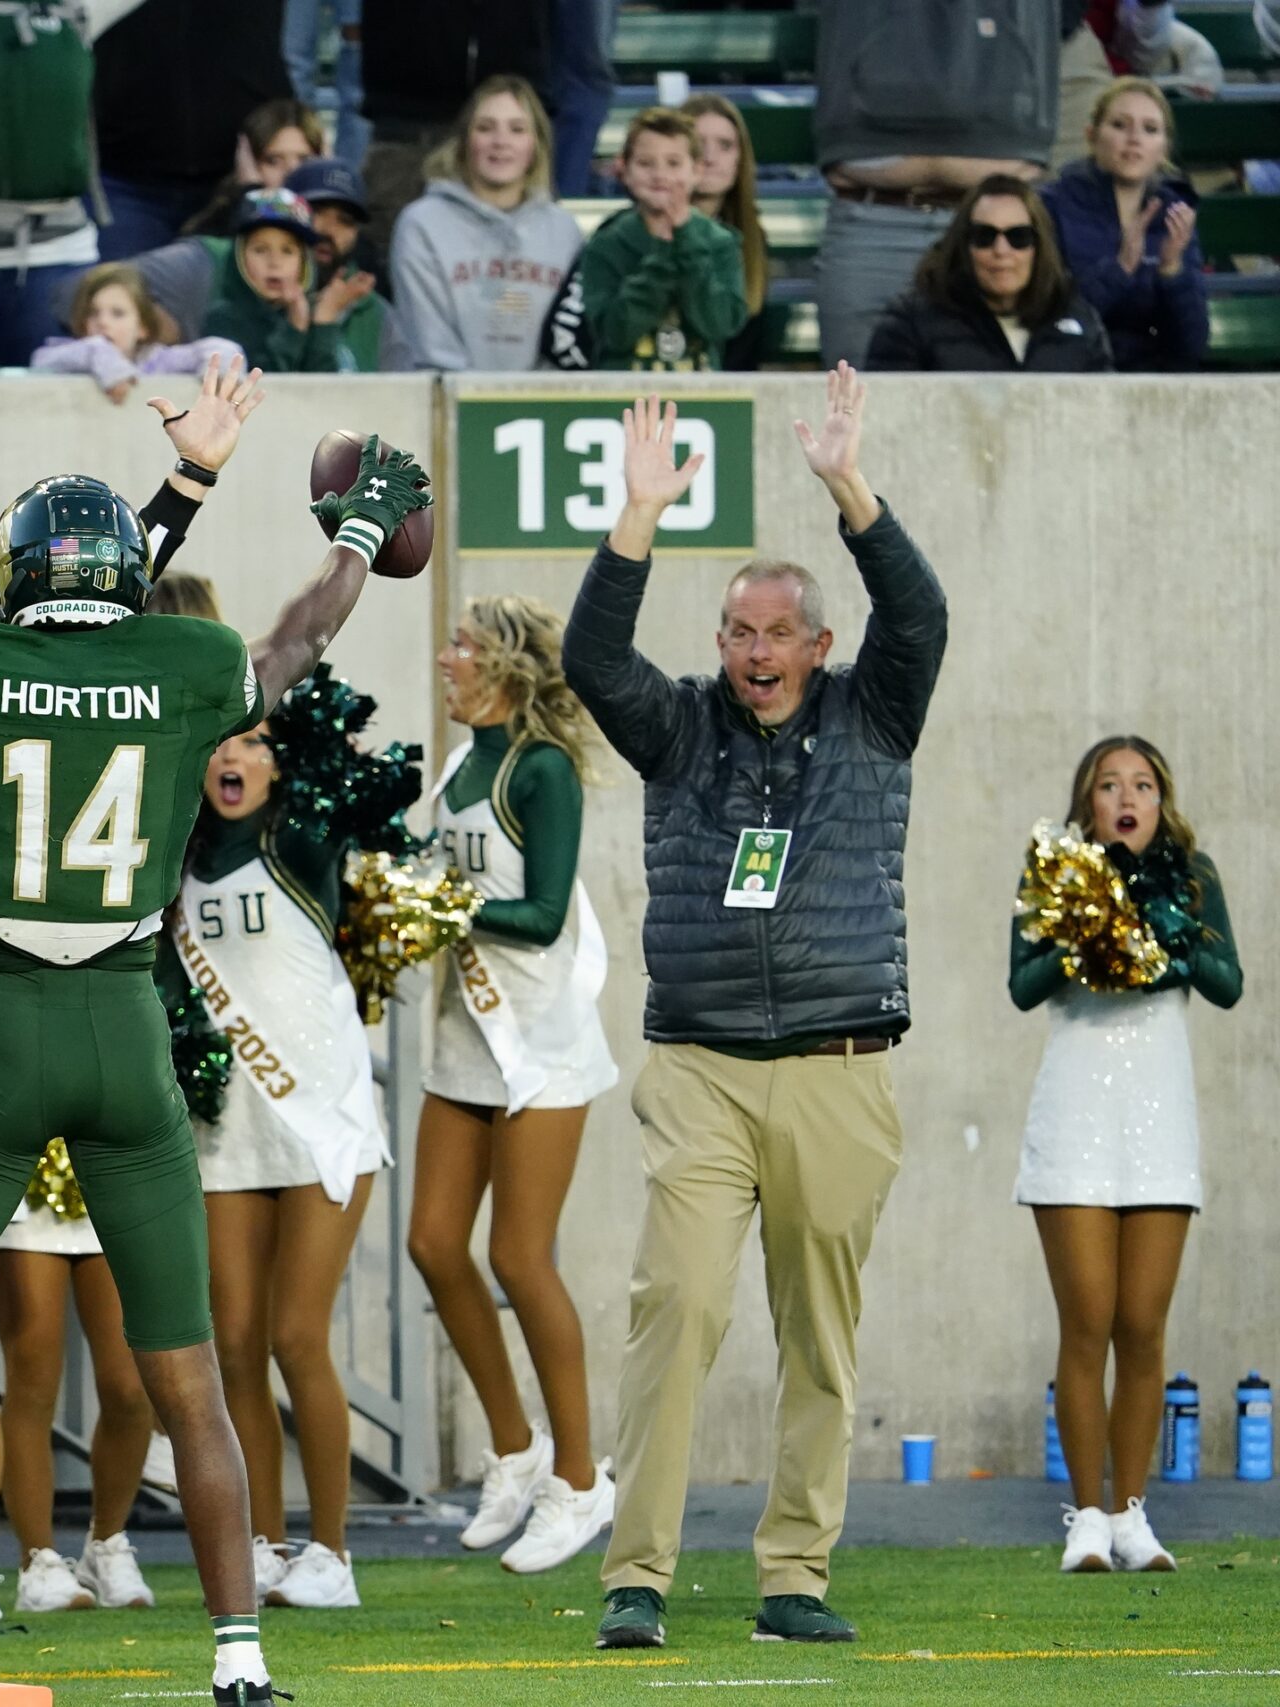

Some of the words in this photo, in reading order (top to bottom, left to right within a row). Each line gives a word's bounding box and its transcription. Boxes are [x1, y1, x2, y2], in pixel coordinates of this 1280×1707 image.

[52, 564, 79, 572] HUSTLE
[36, 603, 96, 615] COLORADO
[100, 605, 127, 617] STATE
[1, 679, 160, 719] HORTON
[3, 739, 150, 907] 14
[456, 939, 500, 1014] 023
[224, 1016, 296, 1100] 2023
